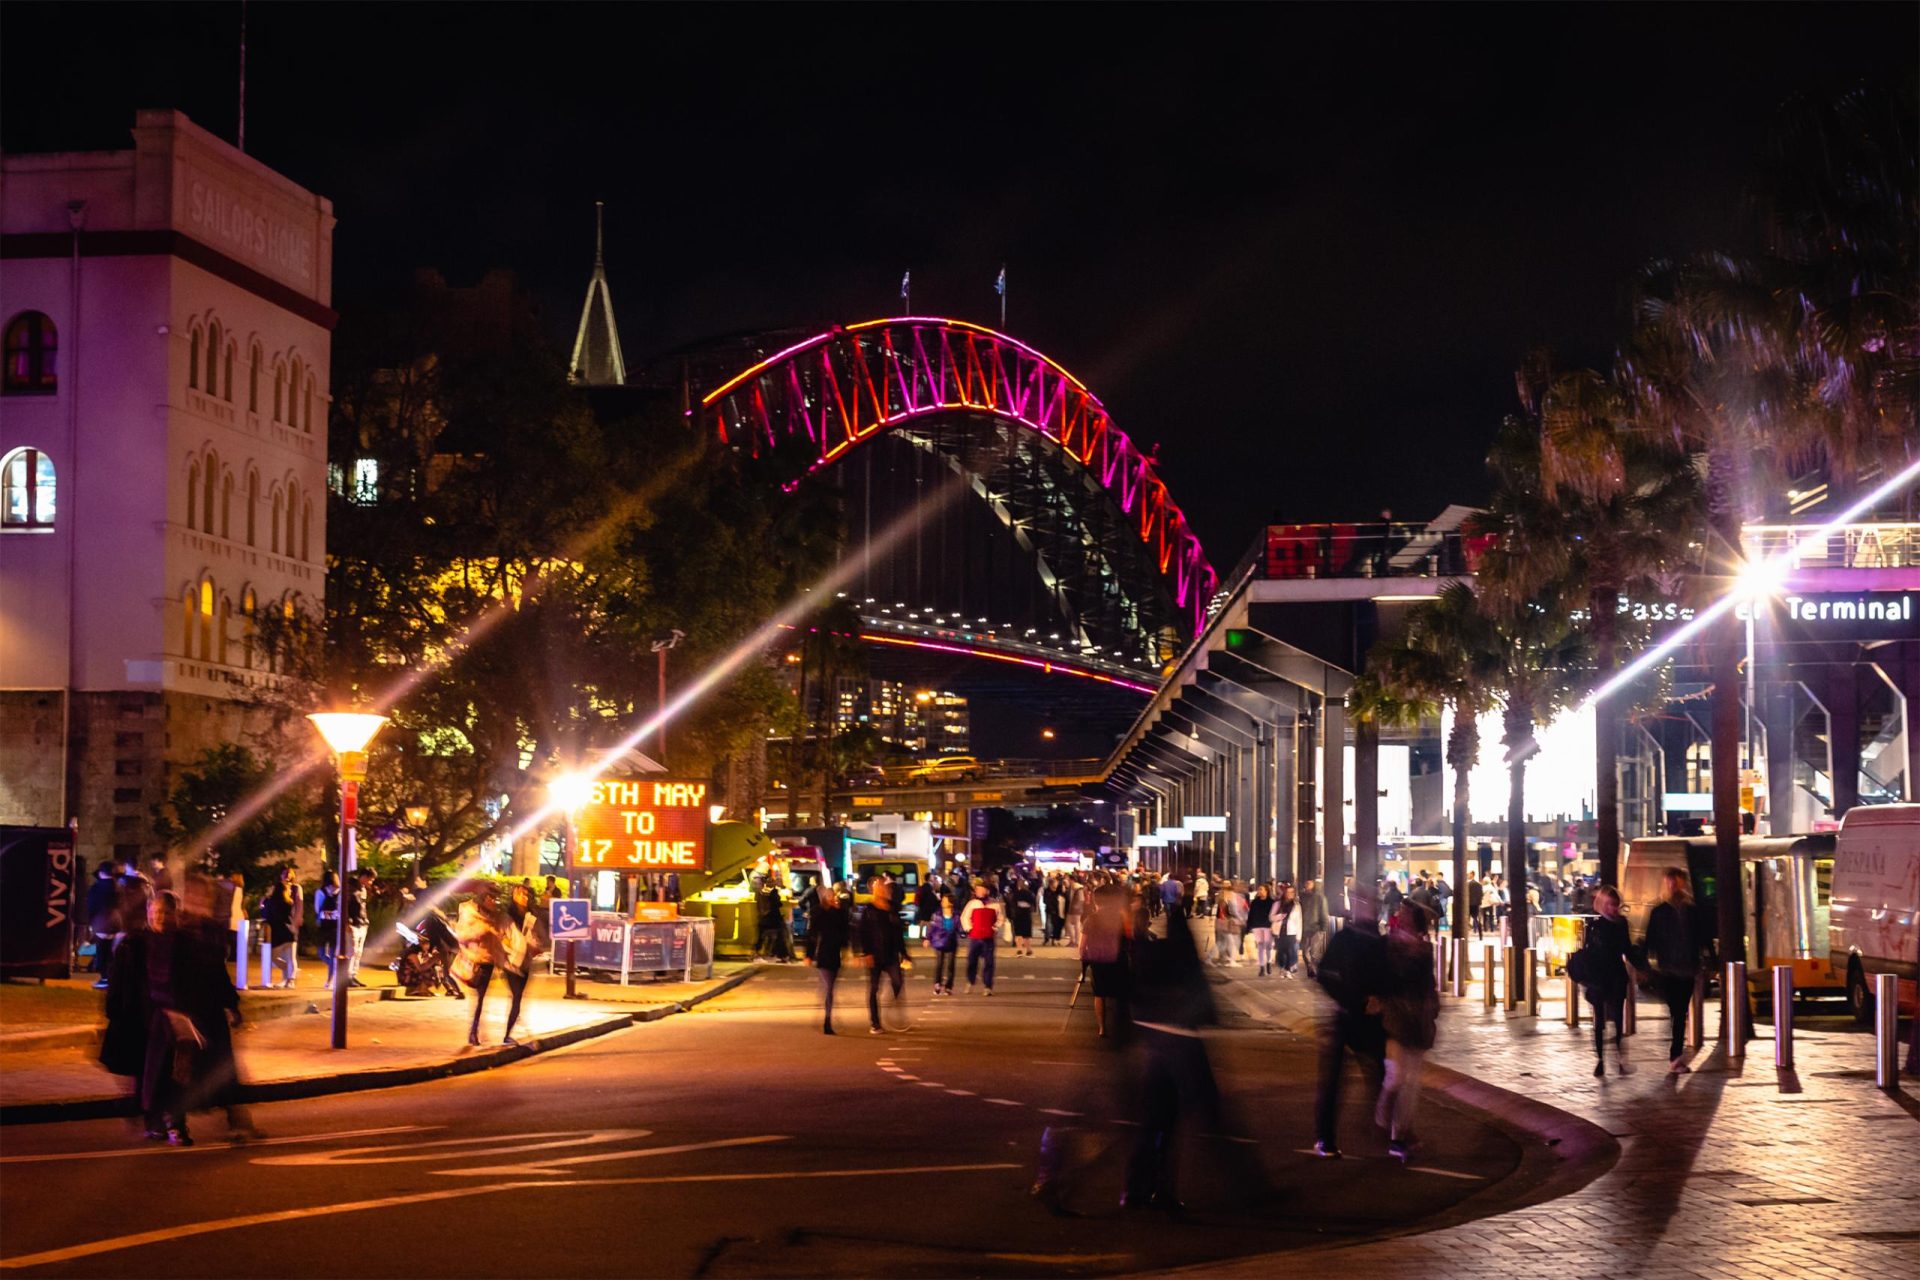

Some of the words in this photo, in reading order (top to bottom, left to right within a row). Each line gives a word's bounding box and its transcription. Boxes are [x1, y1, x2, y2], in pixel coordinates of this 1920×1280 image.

[192, 182, 266, 255] SAILORS
[1617, 593, 1761, 620] Passeer
[1785, 596, 1911, 620] Terminal
[589, 781, 639, 804] 6TH
[653, 783, 706, 807] MAY
[621, 811, 655, 834] TO
[579, 839, 613, 863] 17
[627, 840, 697, 865] JUNE
